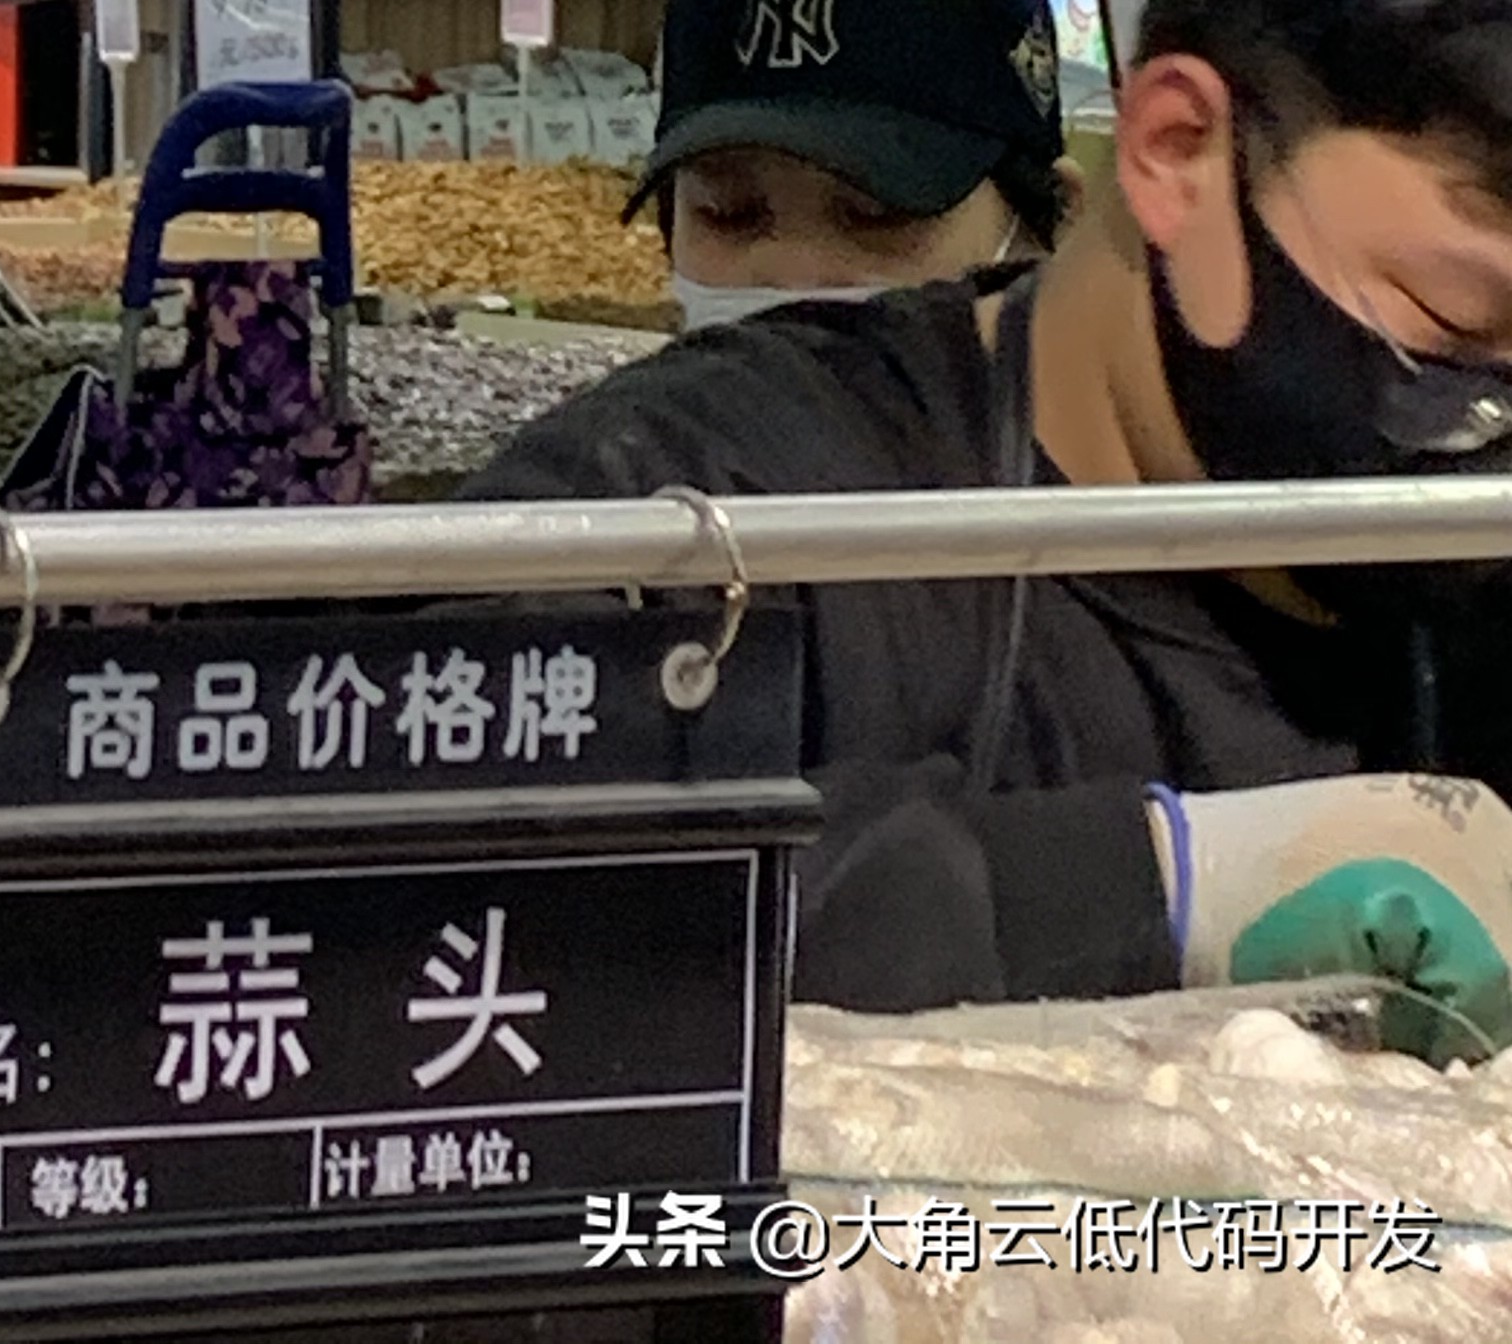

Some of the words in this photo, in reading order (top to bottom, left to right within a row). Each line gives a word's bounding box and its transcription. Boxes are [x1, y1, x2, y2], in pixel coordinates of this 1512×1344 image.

[65, 645, 599, 779] 商品价格牌
[154, 908, 548, 1104] 蒜头
